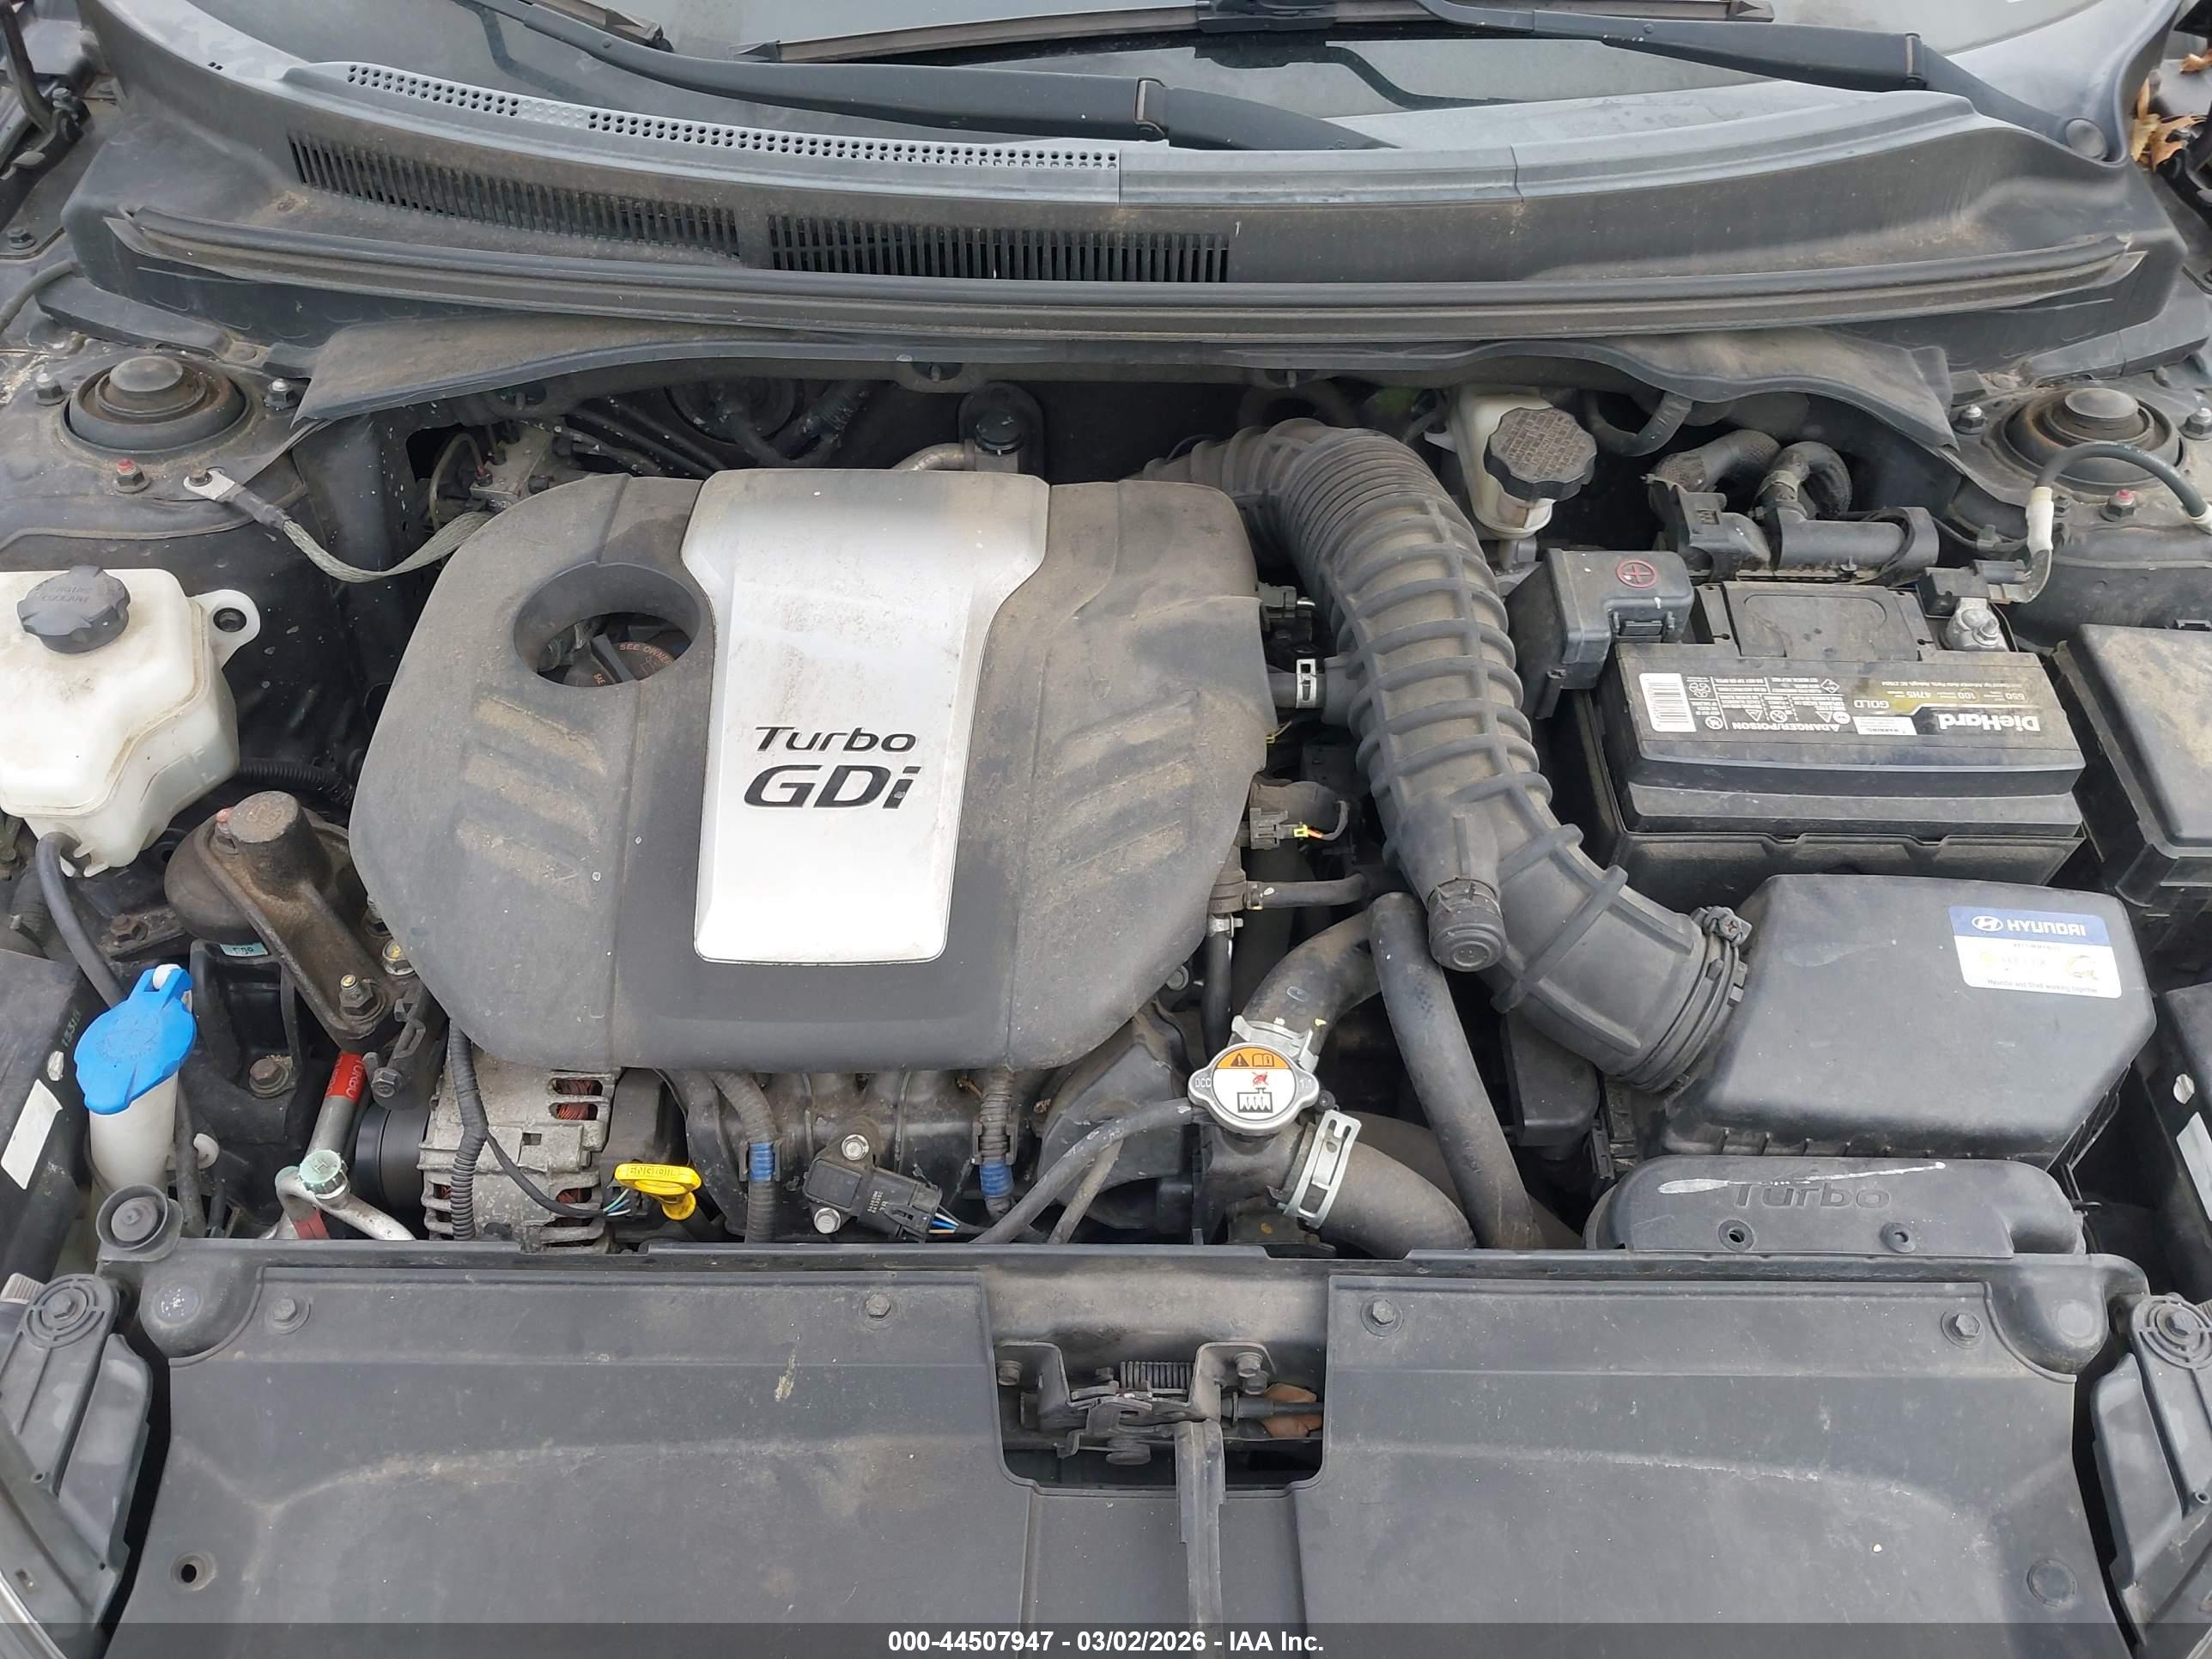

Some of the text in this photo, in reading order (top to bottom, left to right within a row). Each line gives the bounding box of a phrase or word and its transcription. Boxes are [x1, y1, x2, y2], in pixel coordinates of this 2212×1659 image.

[1957, 690, 1976, 700] 100
[1853, 699, 1890, 709] GOLD
[1938, 714, 2041, 732] DieHard
[755, 726, 917, 753] Turbo
[744, 763, 922, 809] GDi
[2006, 919, 2087, 937] HYUNDAI
[2014, 980, 2027, 988] and
[1194, 1077, 1212, 1088] DCC
[655, 1167, 677, 1177] OIL
[1730, 1182, 1891, 1209] Turbo
